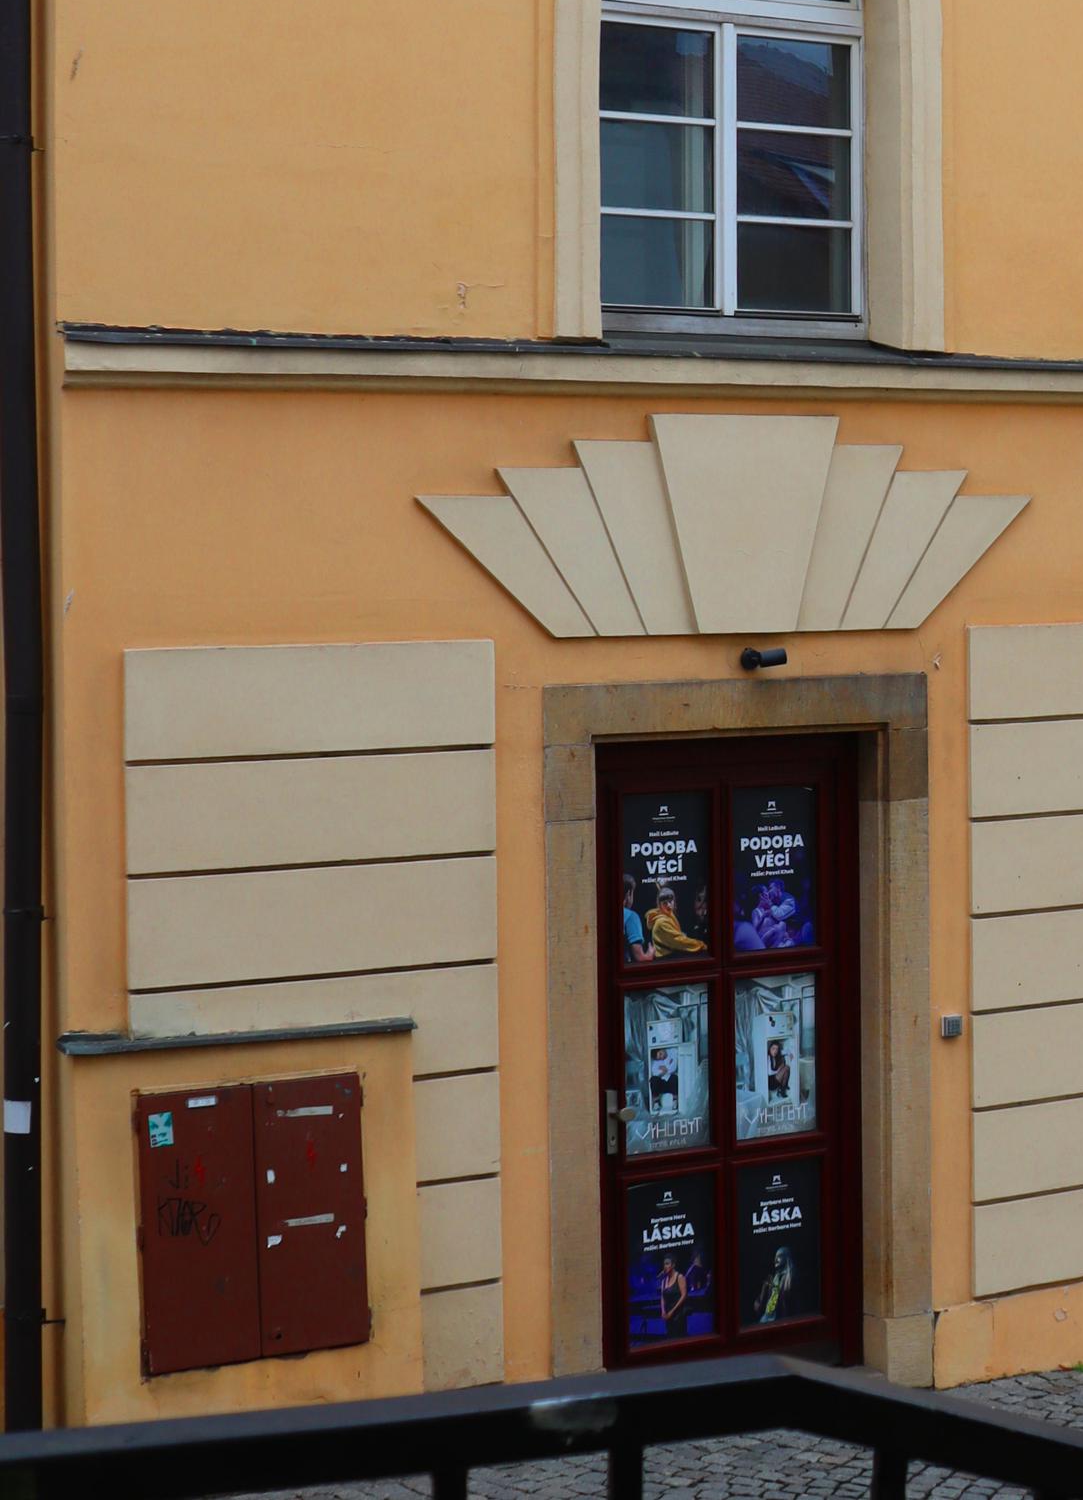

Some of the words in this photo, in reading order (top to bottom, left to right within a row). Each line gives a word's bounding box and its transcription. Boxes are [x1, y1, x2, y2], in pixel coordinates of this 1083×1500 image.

[631, 840, 697, 857] PODOBA
[740, 834, 804, 851] PODOBA
[646, 854, 683, 874] VĚCÍ
[754, 848, 790, 868] VĚCÍ
[752, 1206, 802, 1226] LÁSKA
[643, 1223, 695, 1243] LÁSKA
